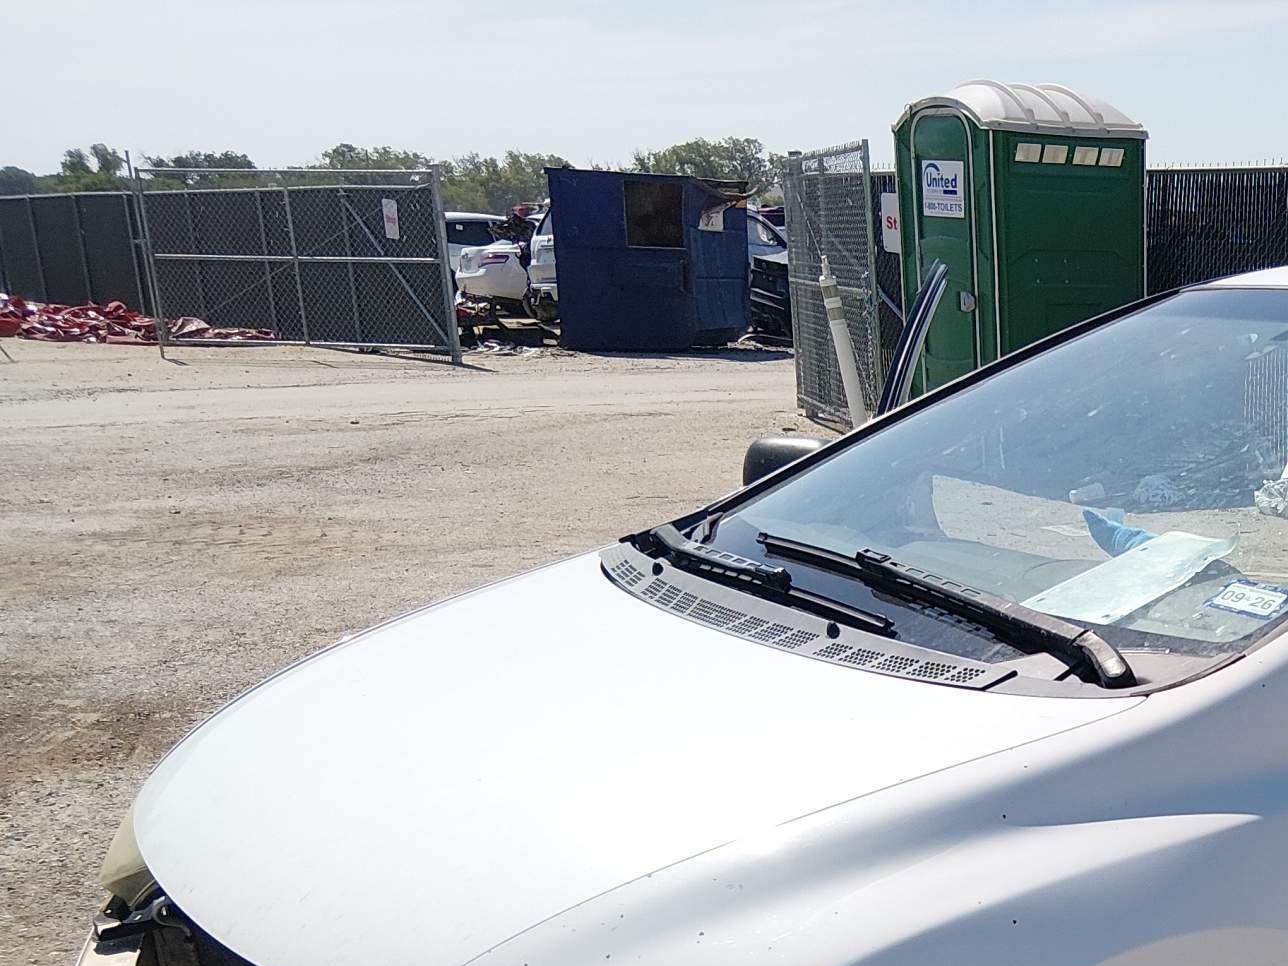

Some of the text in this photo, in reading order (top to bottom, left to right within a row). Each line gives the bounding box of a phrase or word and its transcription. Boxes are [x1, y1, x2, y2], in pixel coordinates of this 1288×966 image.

[926, 173, 957, 188] United
[1221, 590, 1277, 610] 09 26
